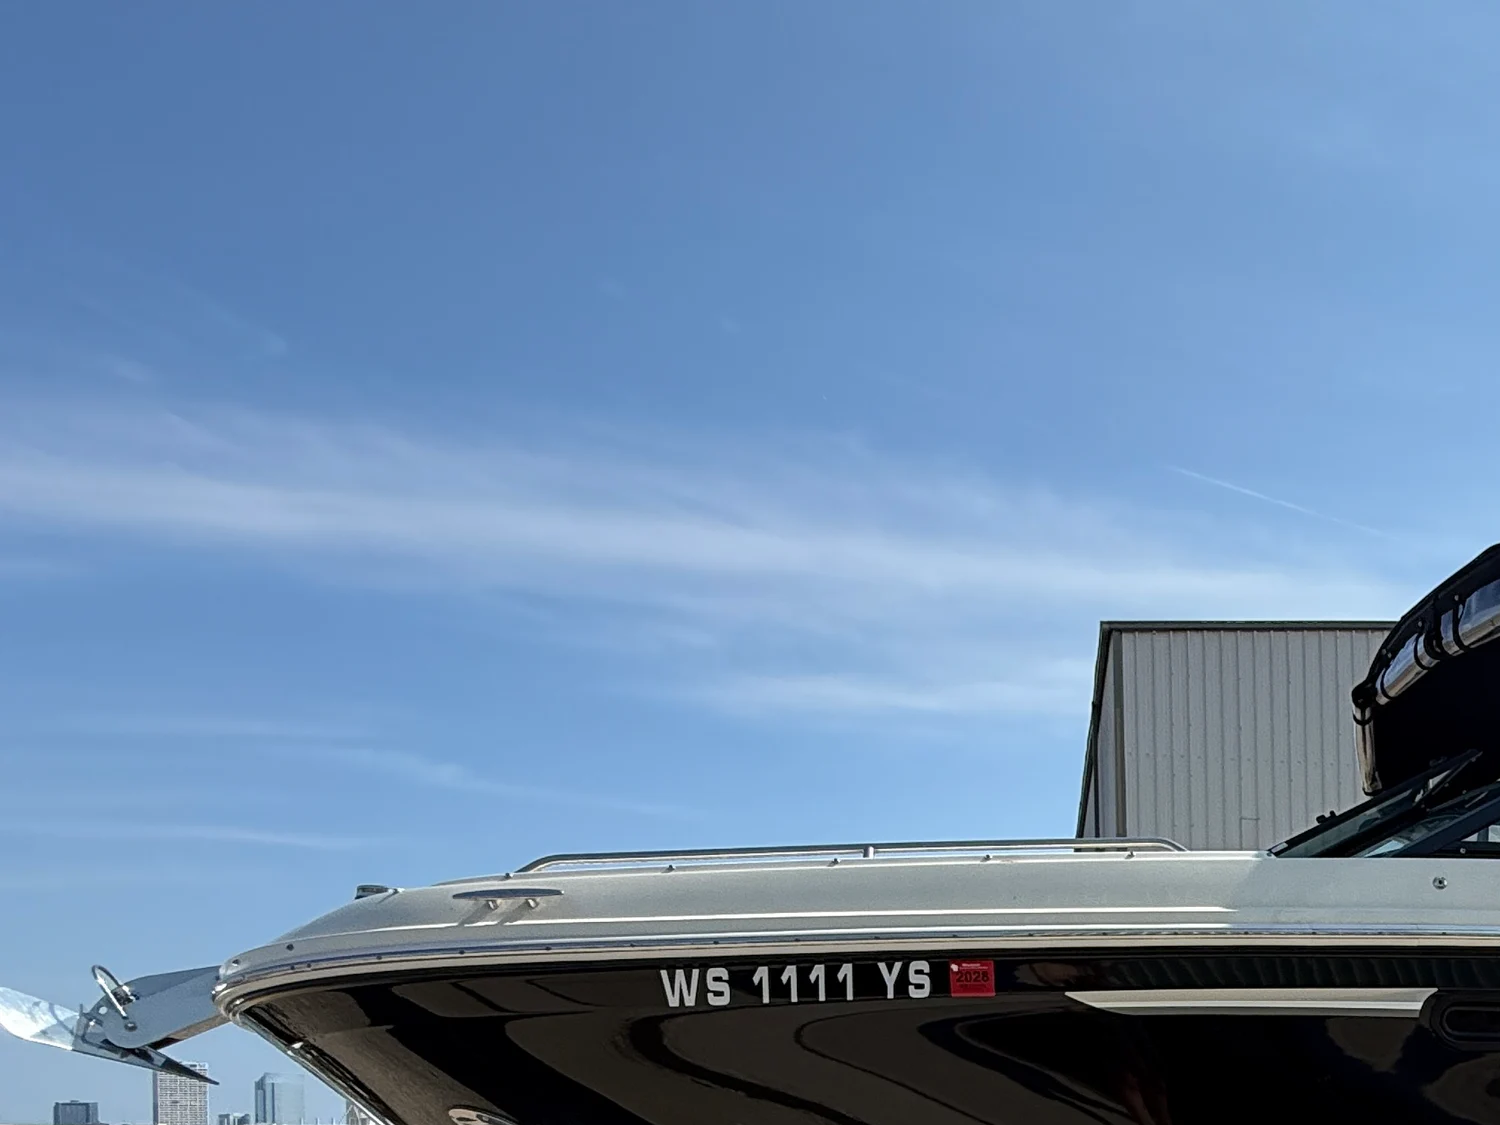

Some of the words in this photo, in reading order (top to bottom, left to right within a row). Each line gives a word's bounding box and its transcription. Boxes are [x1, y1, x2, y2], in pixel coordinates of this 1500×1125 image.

[659, 966, 731, 1008] WS
[751, 962, 855, 1005] 1111
[876, 959, 931, 1000] YS
